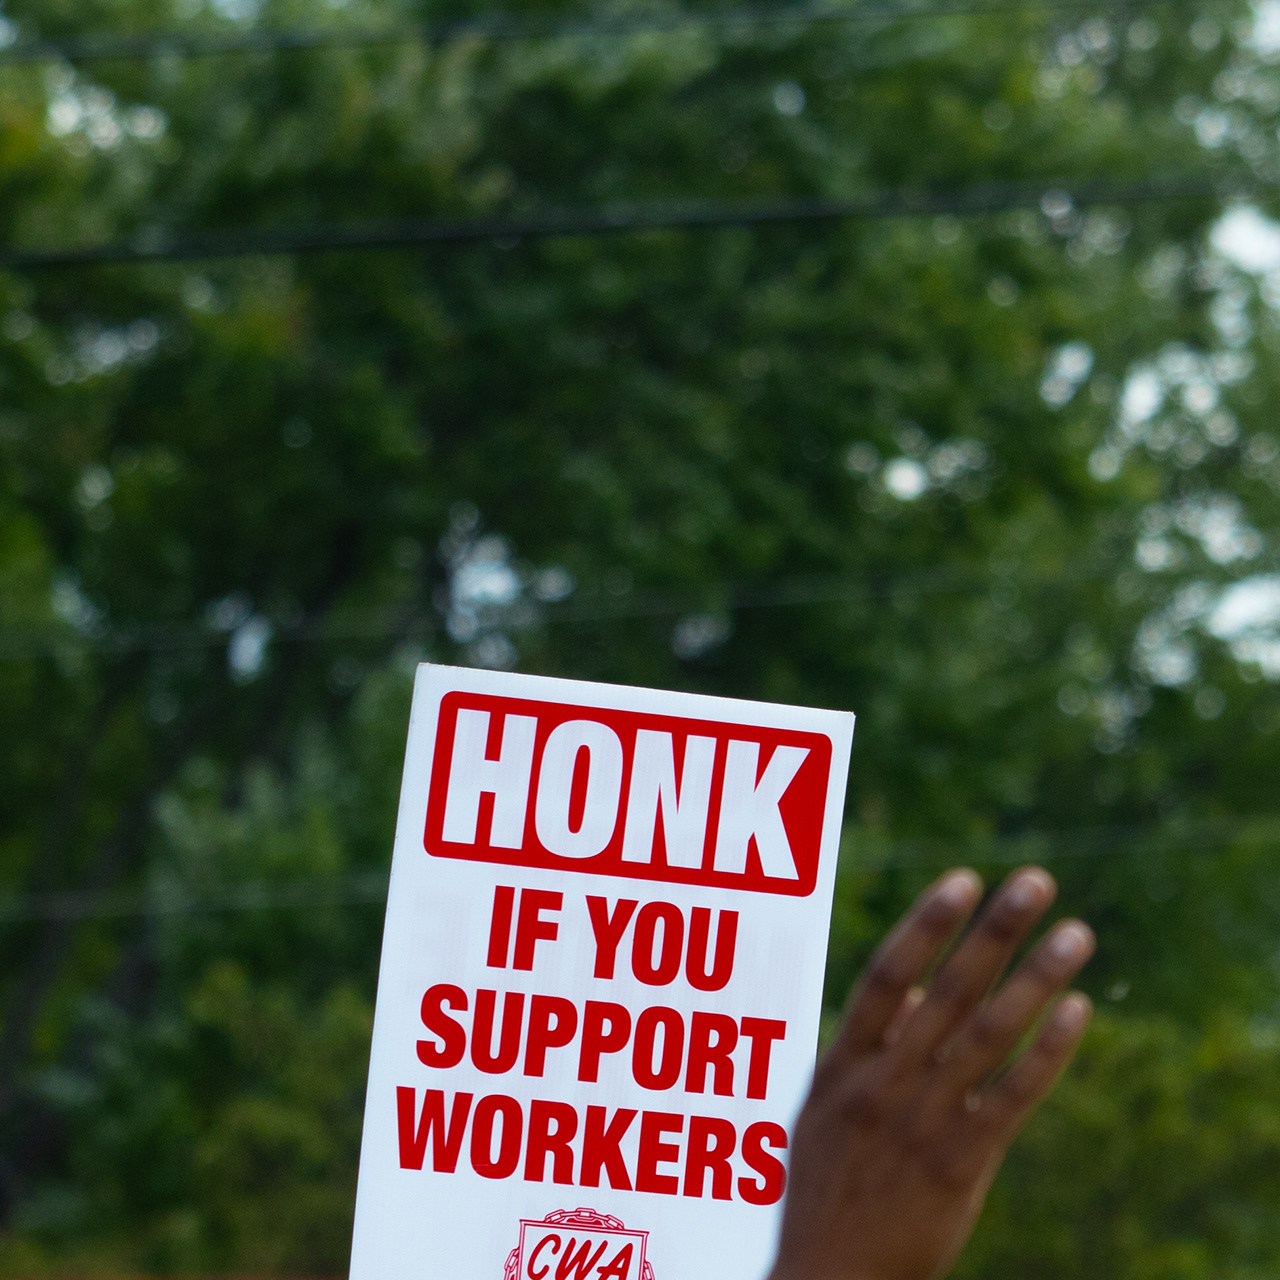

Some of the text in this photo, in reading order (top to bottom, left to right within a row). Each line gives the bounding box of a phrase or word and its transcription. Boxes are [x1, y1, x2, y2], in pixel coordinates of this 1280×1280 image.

[442, 708, 811, 880] HONK
[487, 886, 739, 991] IF YOU
[416, 984, 786, 1100] SUPPORT
[396, 1086, 787, 1205] WORKERS
